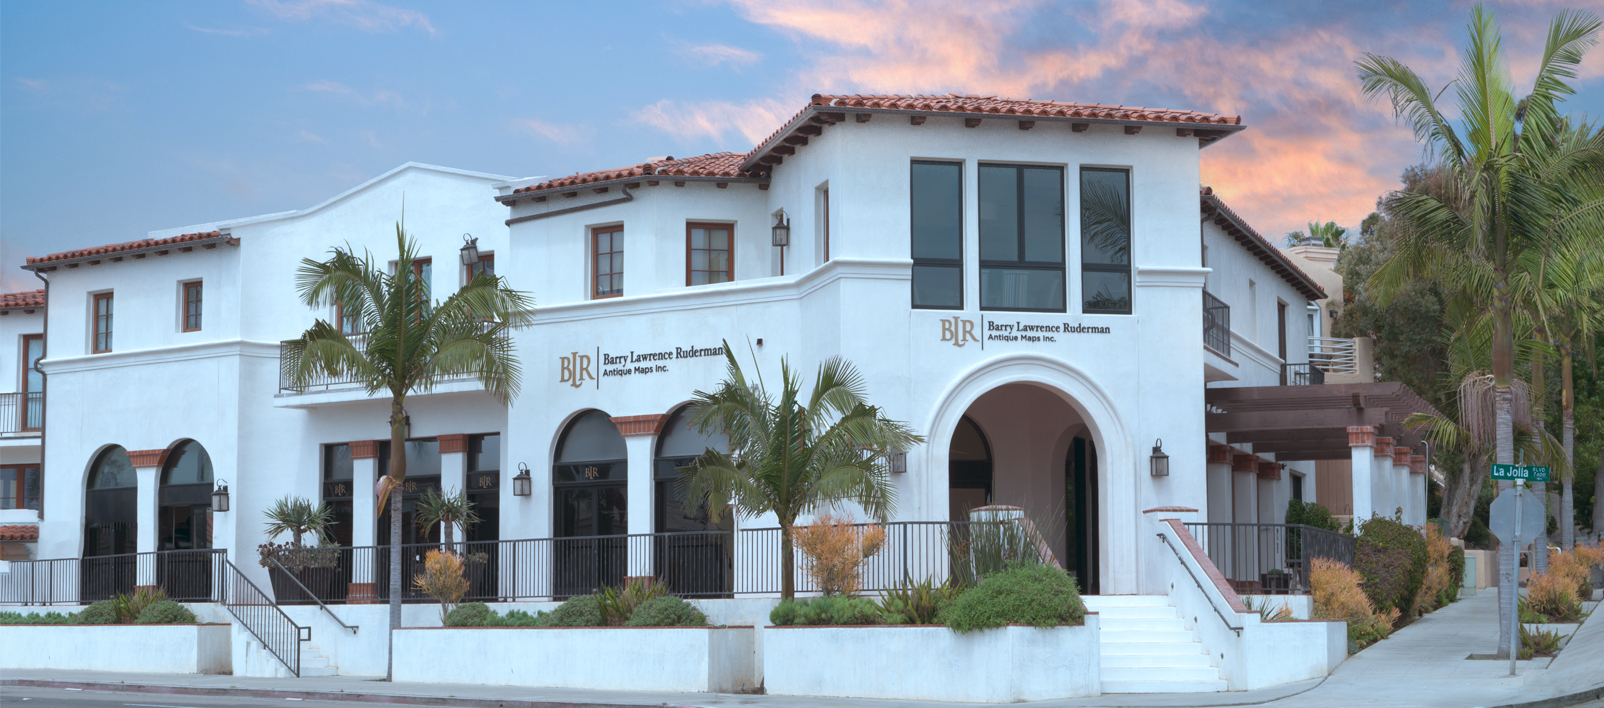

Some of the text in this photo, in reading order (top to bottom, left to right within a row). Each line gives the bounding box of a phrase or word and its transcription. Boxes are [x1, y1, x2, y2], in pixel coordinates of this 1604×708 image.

[940, 316, 979, 347] BLR
[987, 321, 1110, 334] Barry Lawrence Ruderman
[987, 334, 1018, 342] Antique
[603, 345, 724, 367] Barry Lawrence Ruderman
[559, 352, 595, 388] BLR
[603, 364, 668, 377] Antique Maps Inc.
[585, 466, 599, 479] BLR
[1494, 466, 1528, 477] La Jolla
[405, 481, 417, 492] BLR
[480, 476, 492, 488] BLR
[335, 484, 346, 496] BLR
